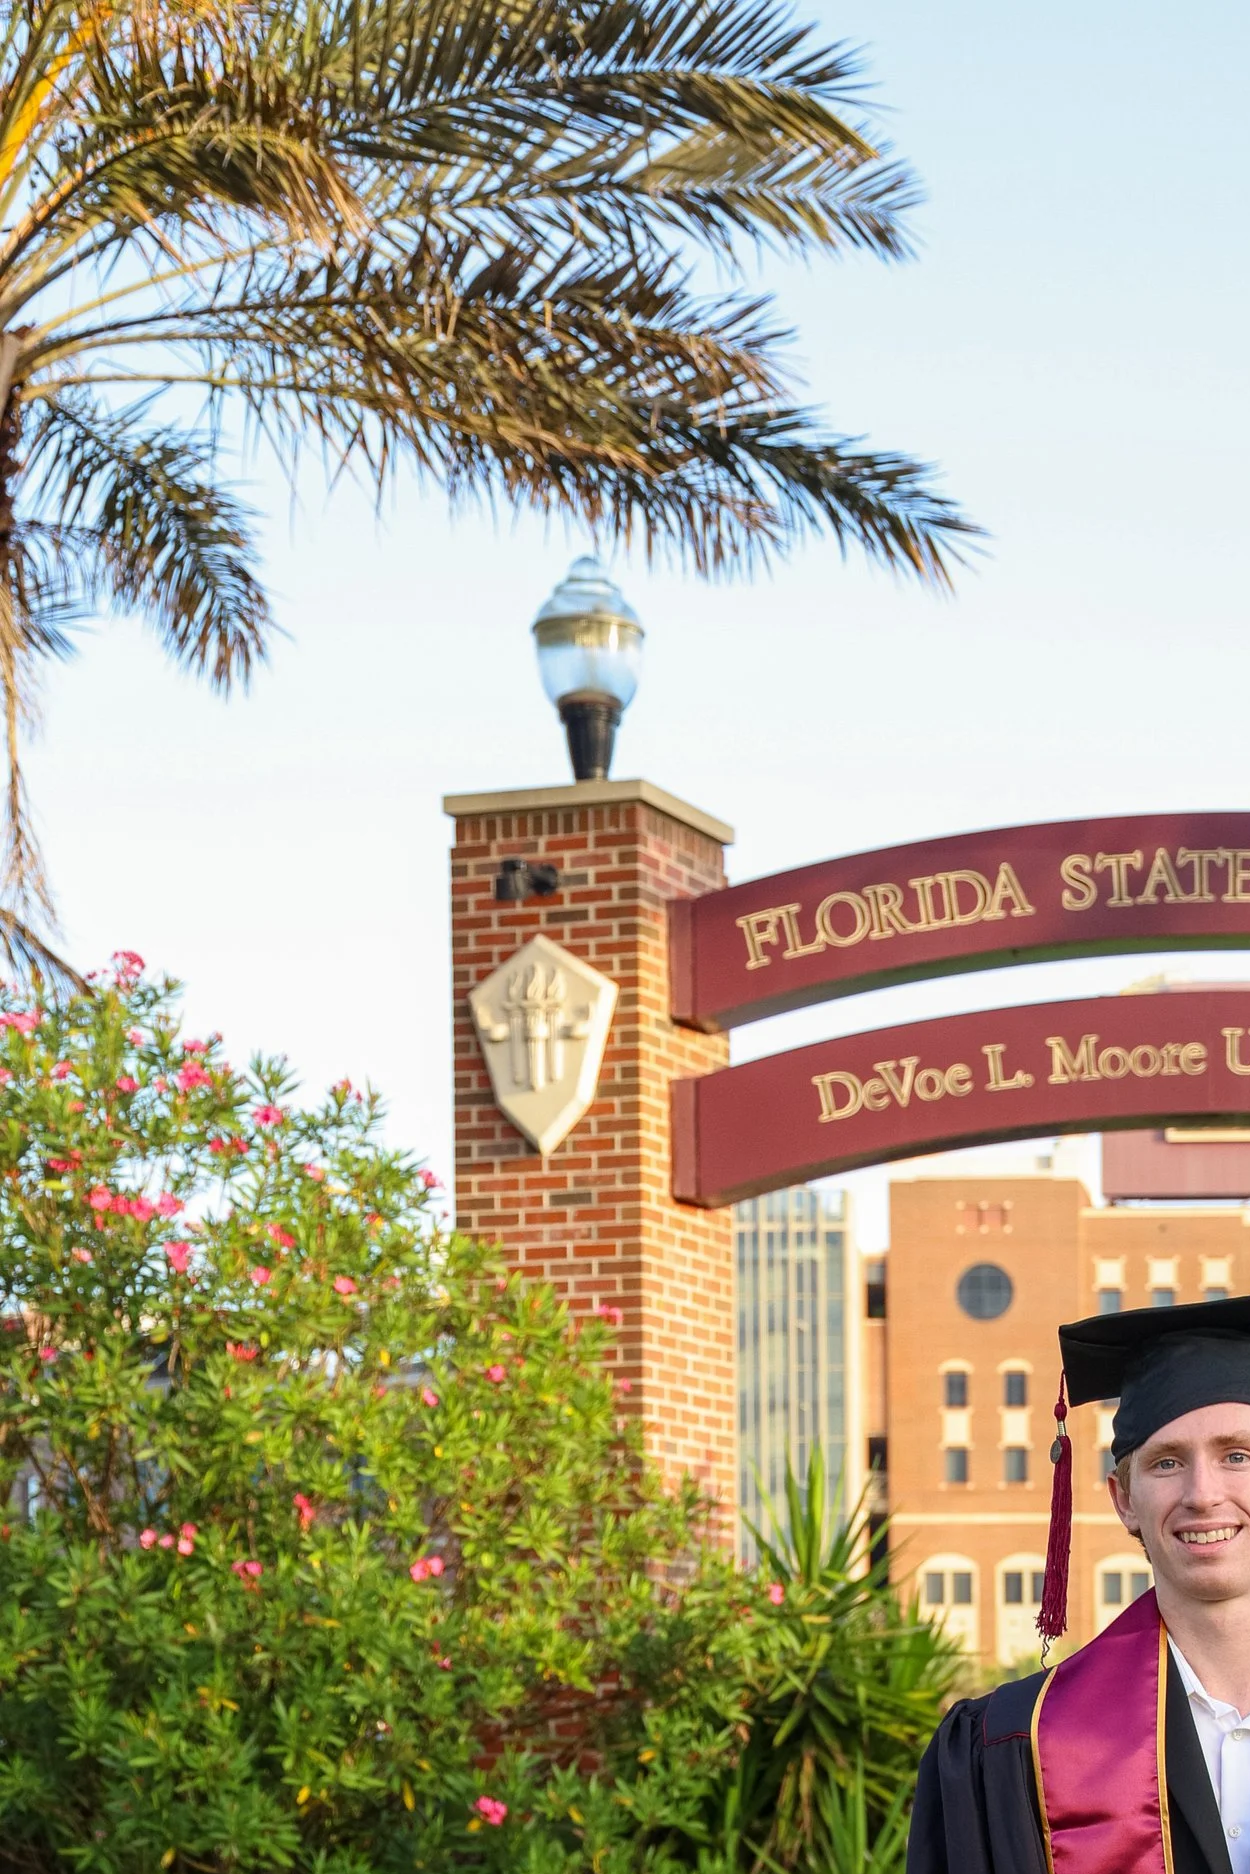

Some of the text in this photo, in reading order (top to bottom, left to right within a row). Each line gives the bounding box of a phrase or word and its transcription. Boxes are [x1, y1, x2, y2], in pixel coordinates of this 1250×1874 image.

[736, 862, 1036, 970] FLORIDA
[812, 1056, 973, 1123] DeVoe
[981, 1043, 1034, 1092] L.
[1045, 1034, 1208, 1085] Moore
